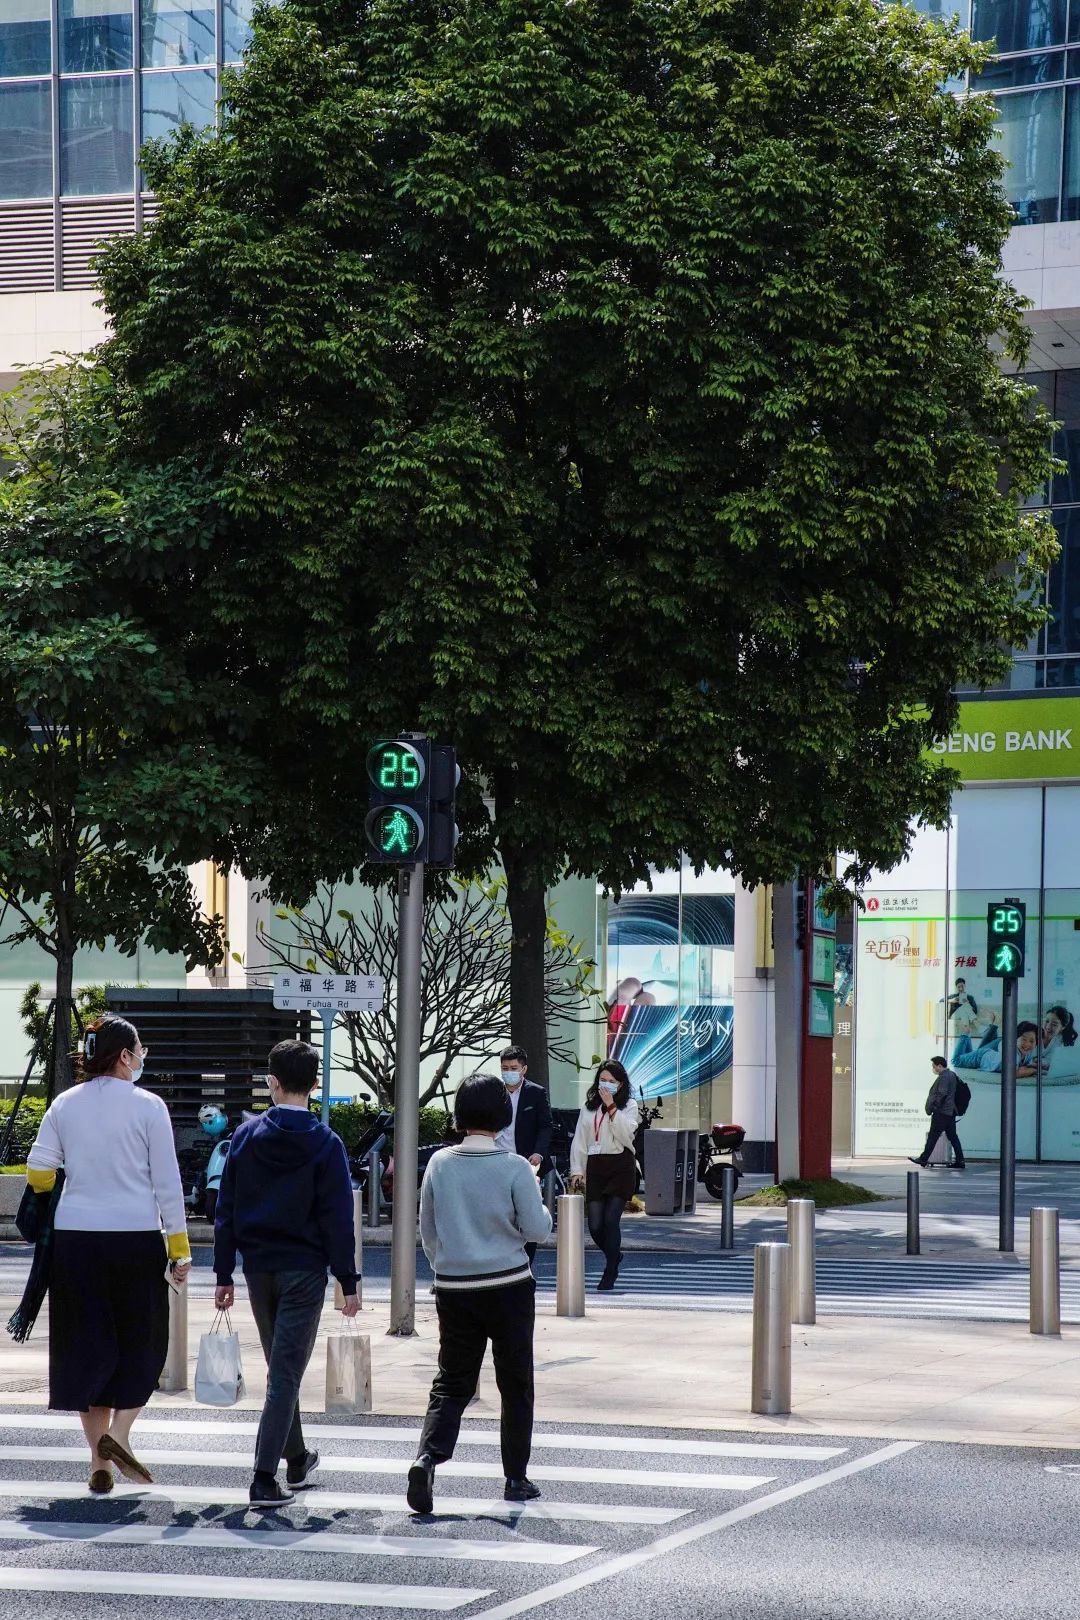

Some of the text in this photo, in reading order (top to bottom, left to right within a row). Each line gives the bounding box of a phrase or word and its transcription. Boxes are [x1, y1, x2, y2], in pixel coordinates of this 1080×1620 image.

[1005, 729, 1073, 752] BANK
[380, 752, 418, 788] 25
[994, 910, 1019, 932] 25
[865, 940, 902, 953] 全方位
[955, 956, 978, 968] 升级
[282, 978, 375, 993] 西 福华路 东
[306, 1000, 332, 1008] Fuhua
[837, 1022, 851, 1036] 理
